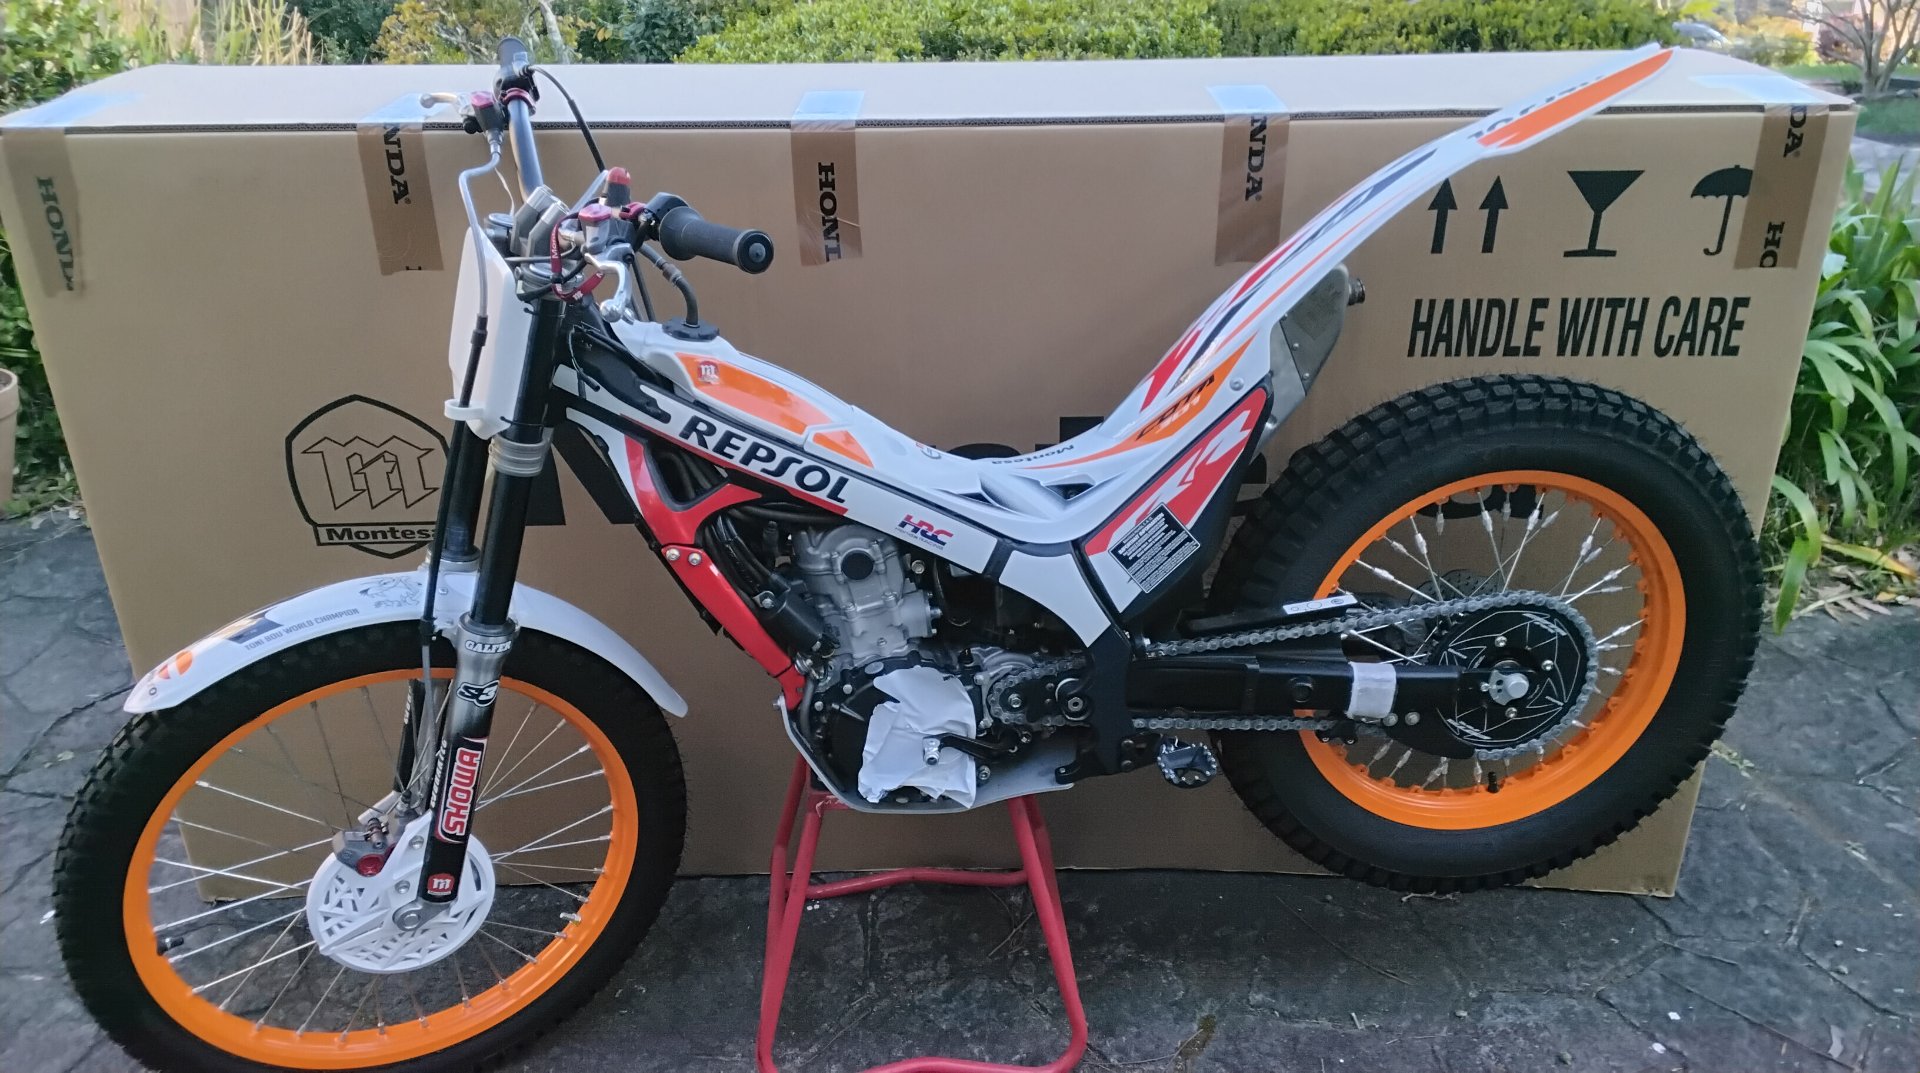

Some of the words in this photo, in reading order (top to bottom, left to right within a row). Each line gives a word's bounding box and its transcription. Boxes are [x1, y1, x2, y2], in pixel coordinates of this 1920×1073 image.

[1407, 297, 1549, 358] HANDLE
[1556, 297, 1650, 357] WITH
[1653, 295, 1751, 358] CARE
[678, 414, 849, 504] REPSOL
[325, 526, 436, 541] Montes
[898, 514, 954, 546] HRC
[244, 639, 265, 651] TONI
[283, 618, 314, 636] WORLD
[314, 607, 360, 624] CHAMPION
[442, 747, 483, 836] SHOWA
